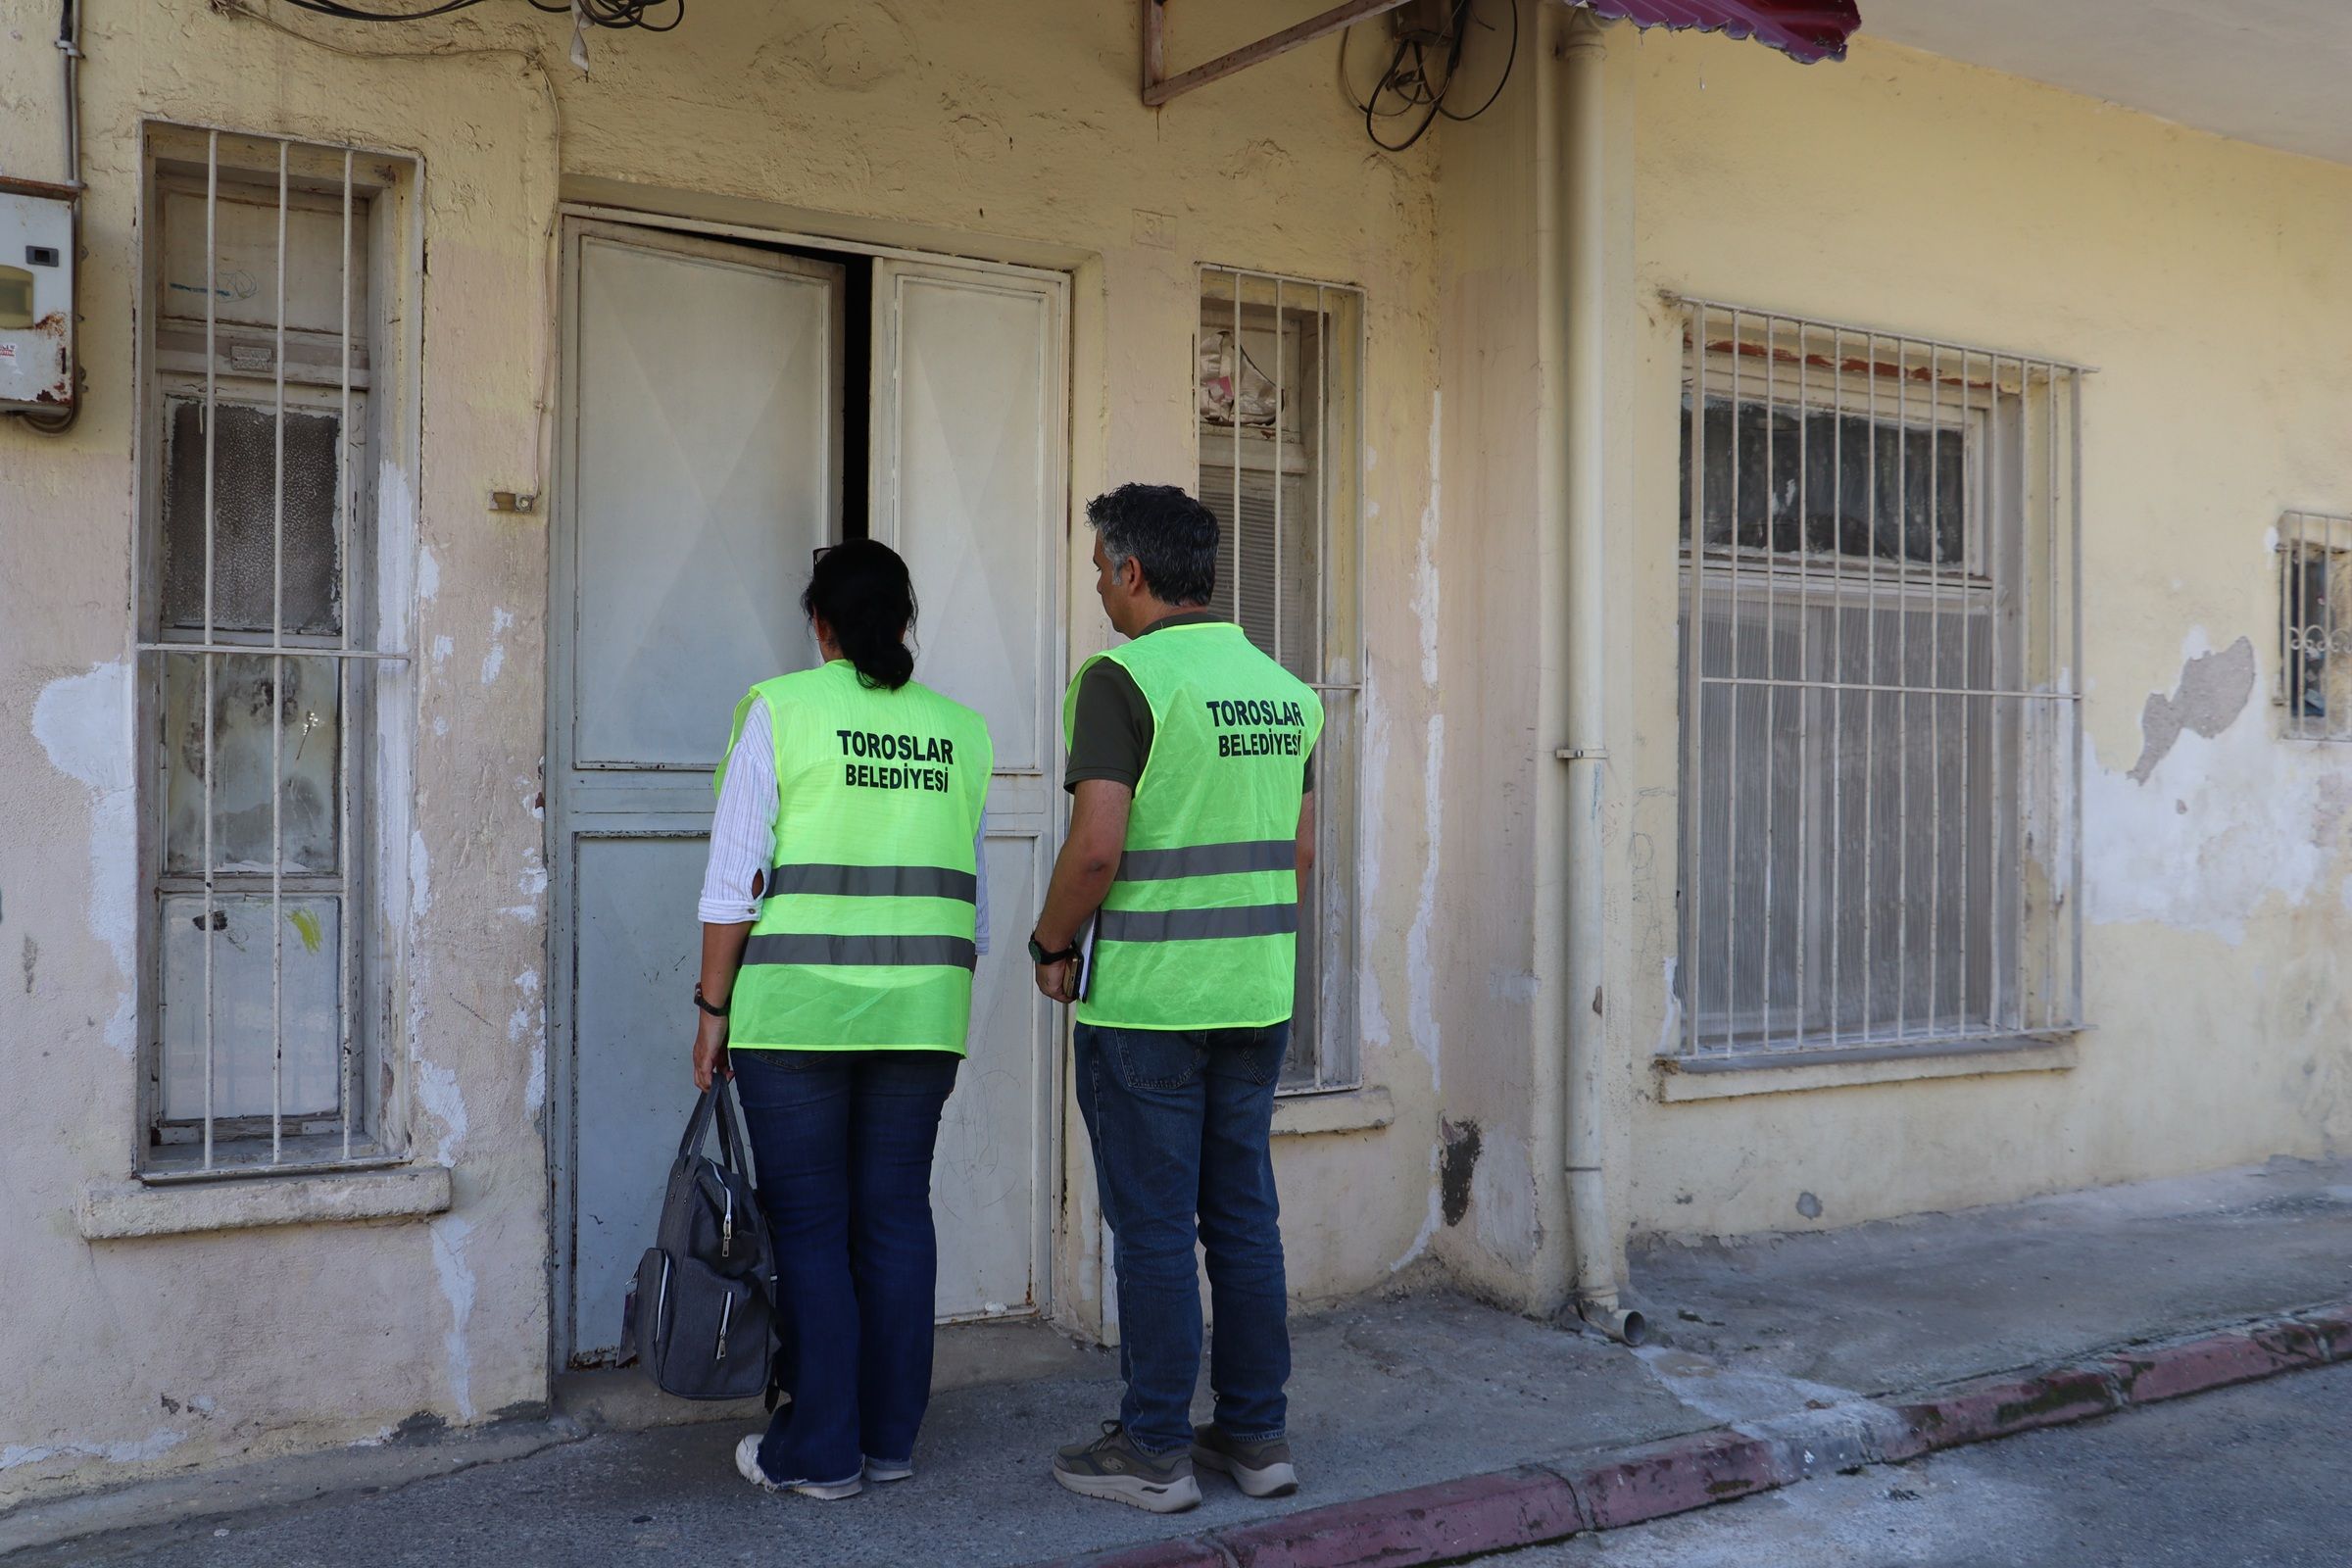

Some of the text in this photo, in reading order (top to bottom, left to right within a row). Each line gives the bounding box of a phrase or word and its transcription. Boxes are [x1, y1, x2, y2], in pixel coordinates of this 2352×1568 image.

[1206, 700, 1304, 727] TOROSLAR
[836, 730, 954, 764] TOROSLAR
[1218, 728, 1301, 757] BELEDİYESİ
[846, 762, 949, 793] BELEDİYESİ
